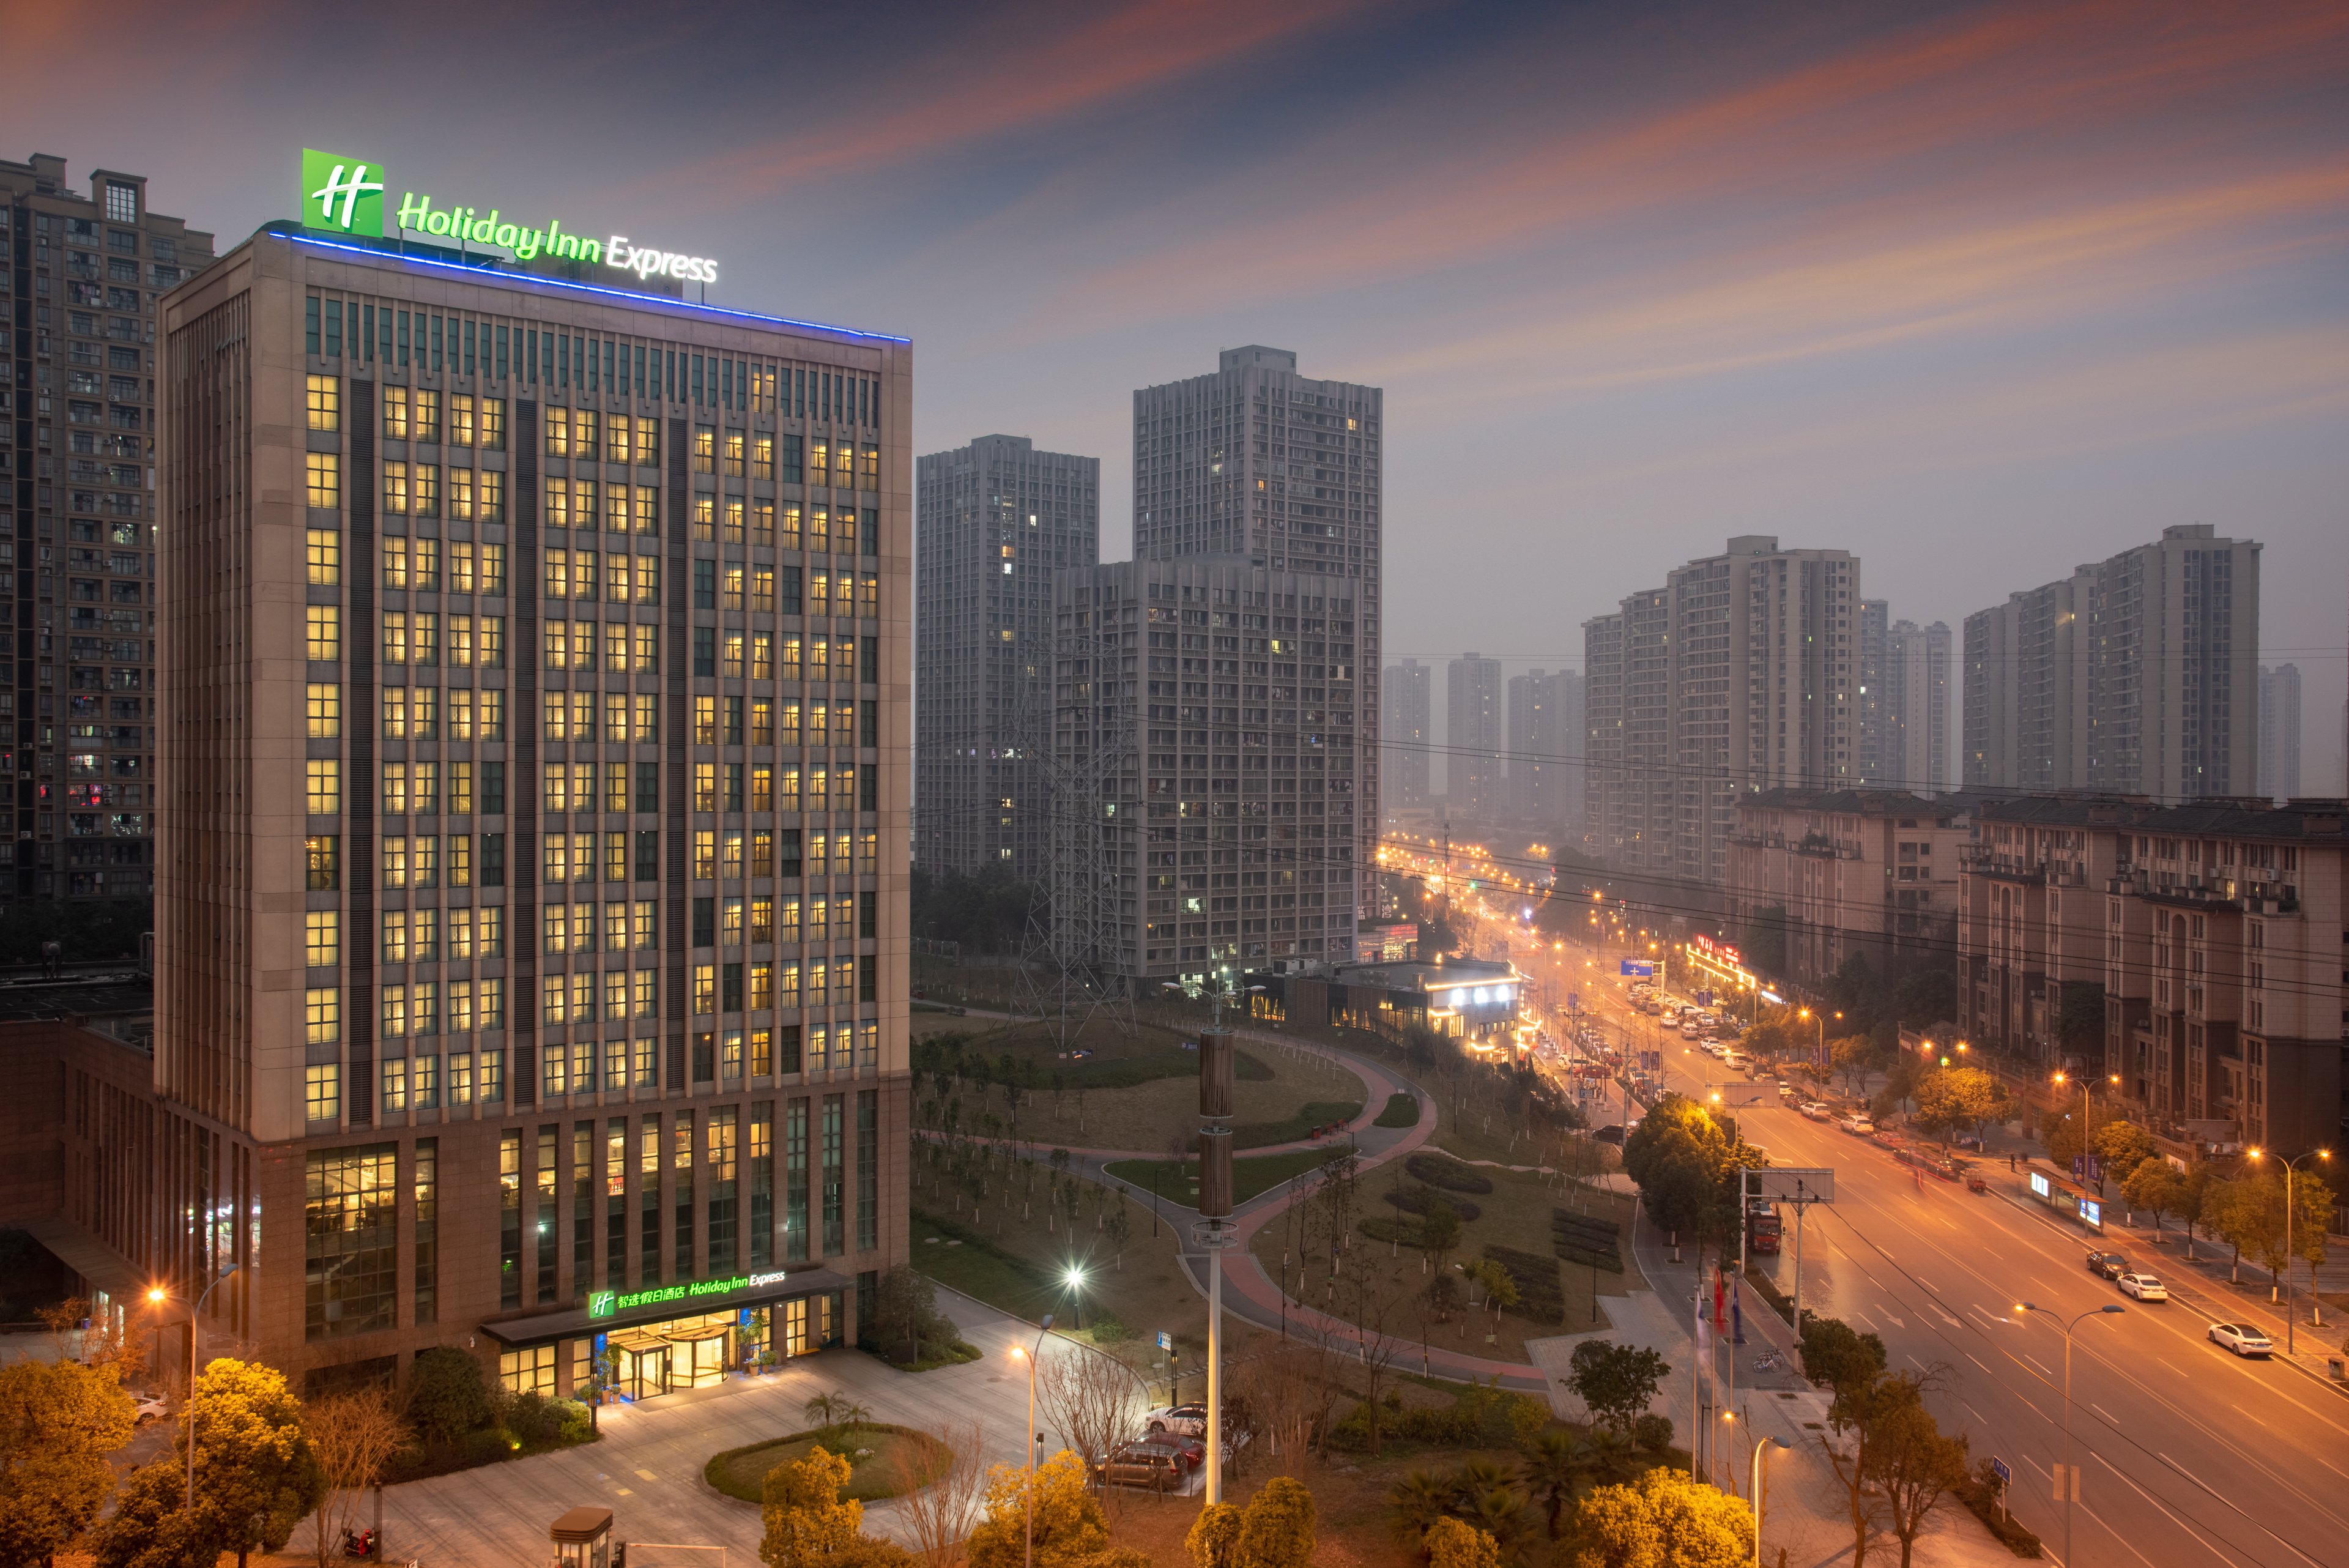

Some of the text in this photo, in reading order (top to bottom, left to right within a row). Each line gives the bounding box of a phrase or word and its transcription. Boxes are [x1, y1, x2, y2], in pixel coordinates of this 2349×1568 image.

[396, 192, 718, 283] Holiday Inn Express
[689, 1272, 785, 1296] Holiday Inn Express
[617, 1286, 686, 1309] 智选假日酒店
